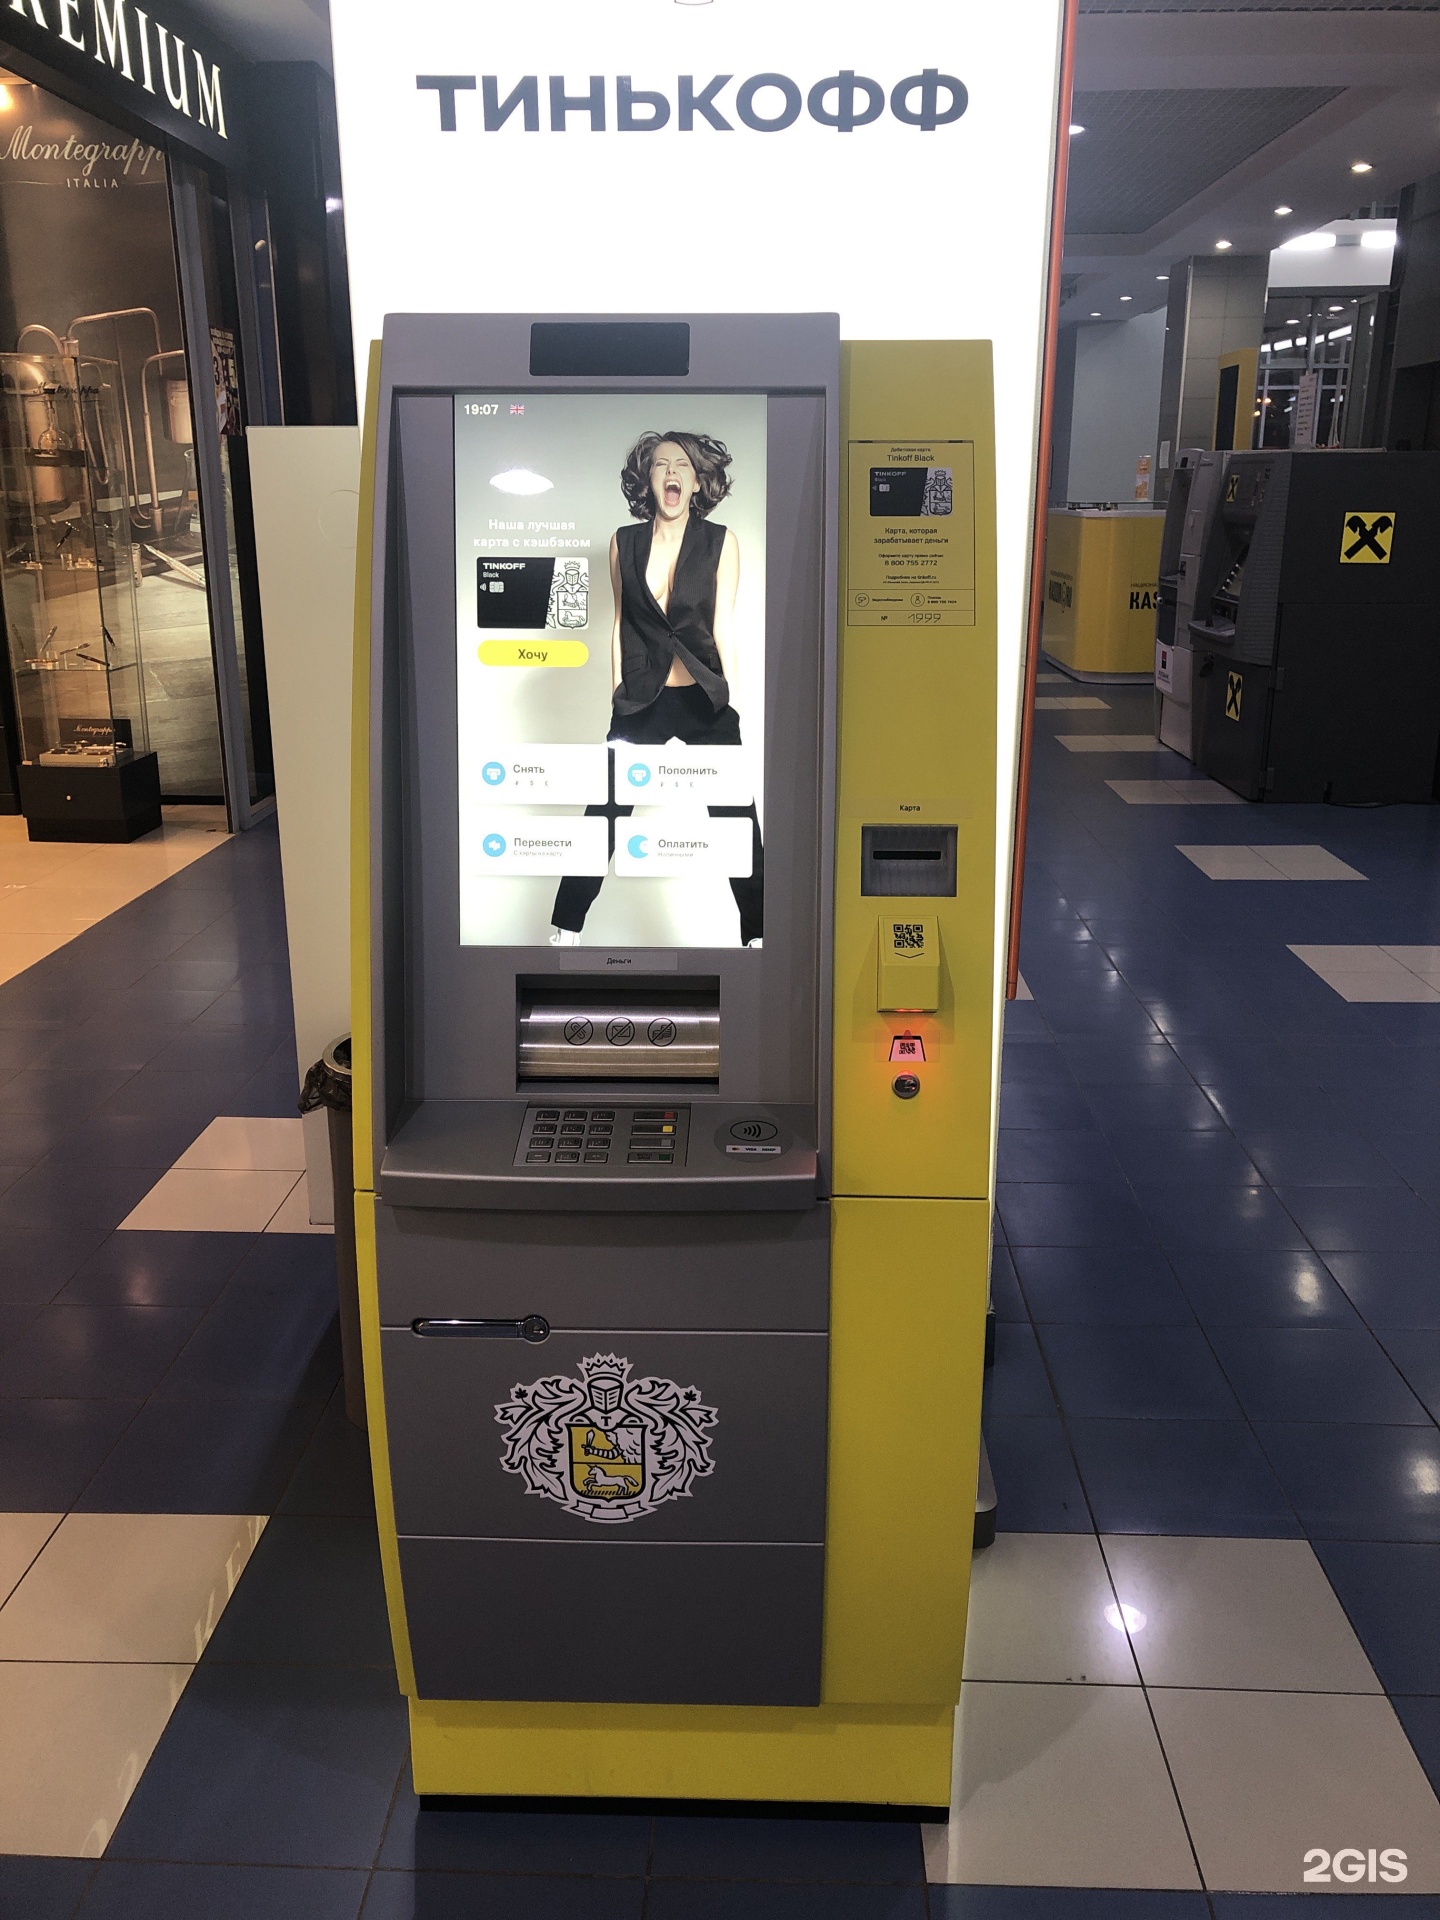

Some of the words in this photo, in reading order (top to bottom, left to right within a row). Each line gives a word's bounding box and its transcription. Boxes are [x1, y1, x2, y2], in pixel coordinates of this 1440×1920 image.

[415, 68, 969, 133] ТИНЬКОФФ
[66, 178, 119, 188] ITALIA
[464, 403, 499, 416] 19:07
[887, 454, 913, 462] Tinkoff
[914, 454, 935, 462] Black
[488, 518, 525, 531] Наша
[527, 520, 576, 533] лучшая
[885, 527, 908, 535] Карта,
[909, 528, 938, 536] которая
[473, 537, 510, 550] карта
[512, 538, 521, 548] с
[523, 536, 592, 549] кэшбэком
[482, 562, 526, 570] TINKOFF
[482, 571, 500, 579] Black
[908, 612, 942, 623] 1999
[517, 648, 549, 662] Хочу
[512, 764, 546, 774] Снять
[658, 765, 718, 775] Пополнить
[899, 804, 921, 812] Карта
[513, 837, 572, 848] Перевести
[658, 838, 709, 849] Оплатить
[606, 957, 632, 965] Деньги
